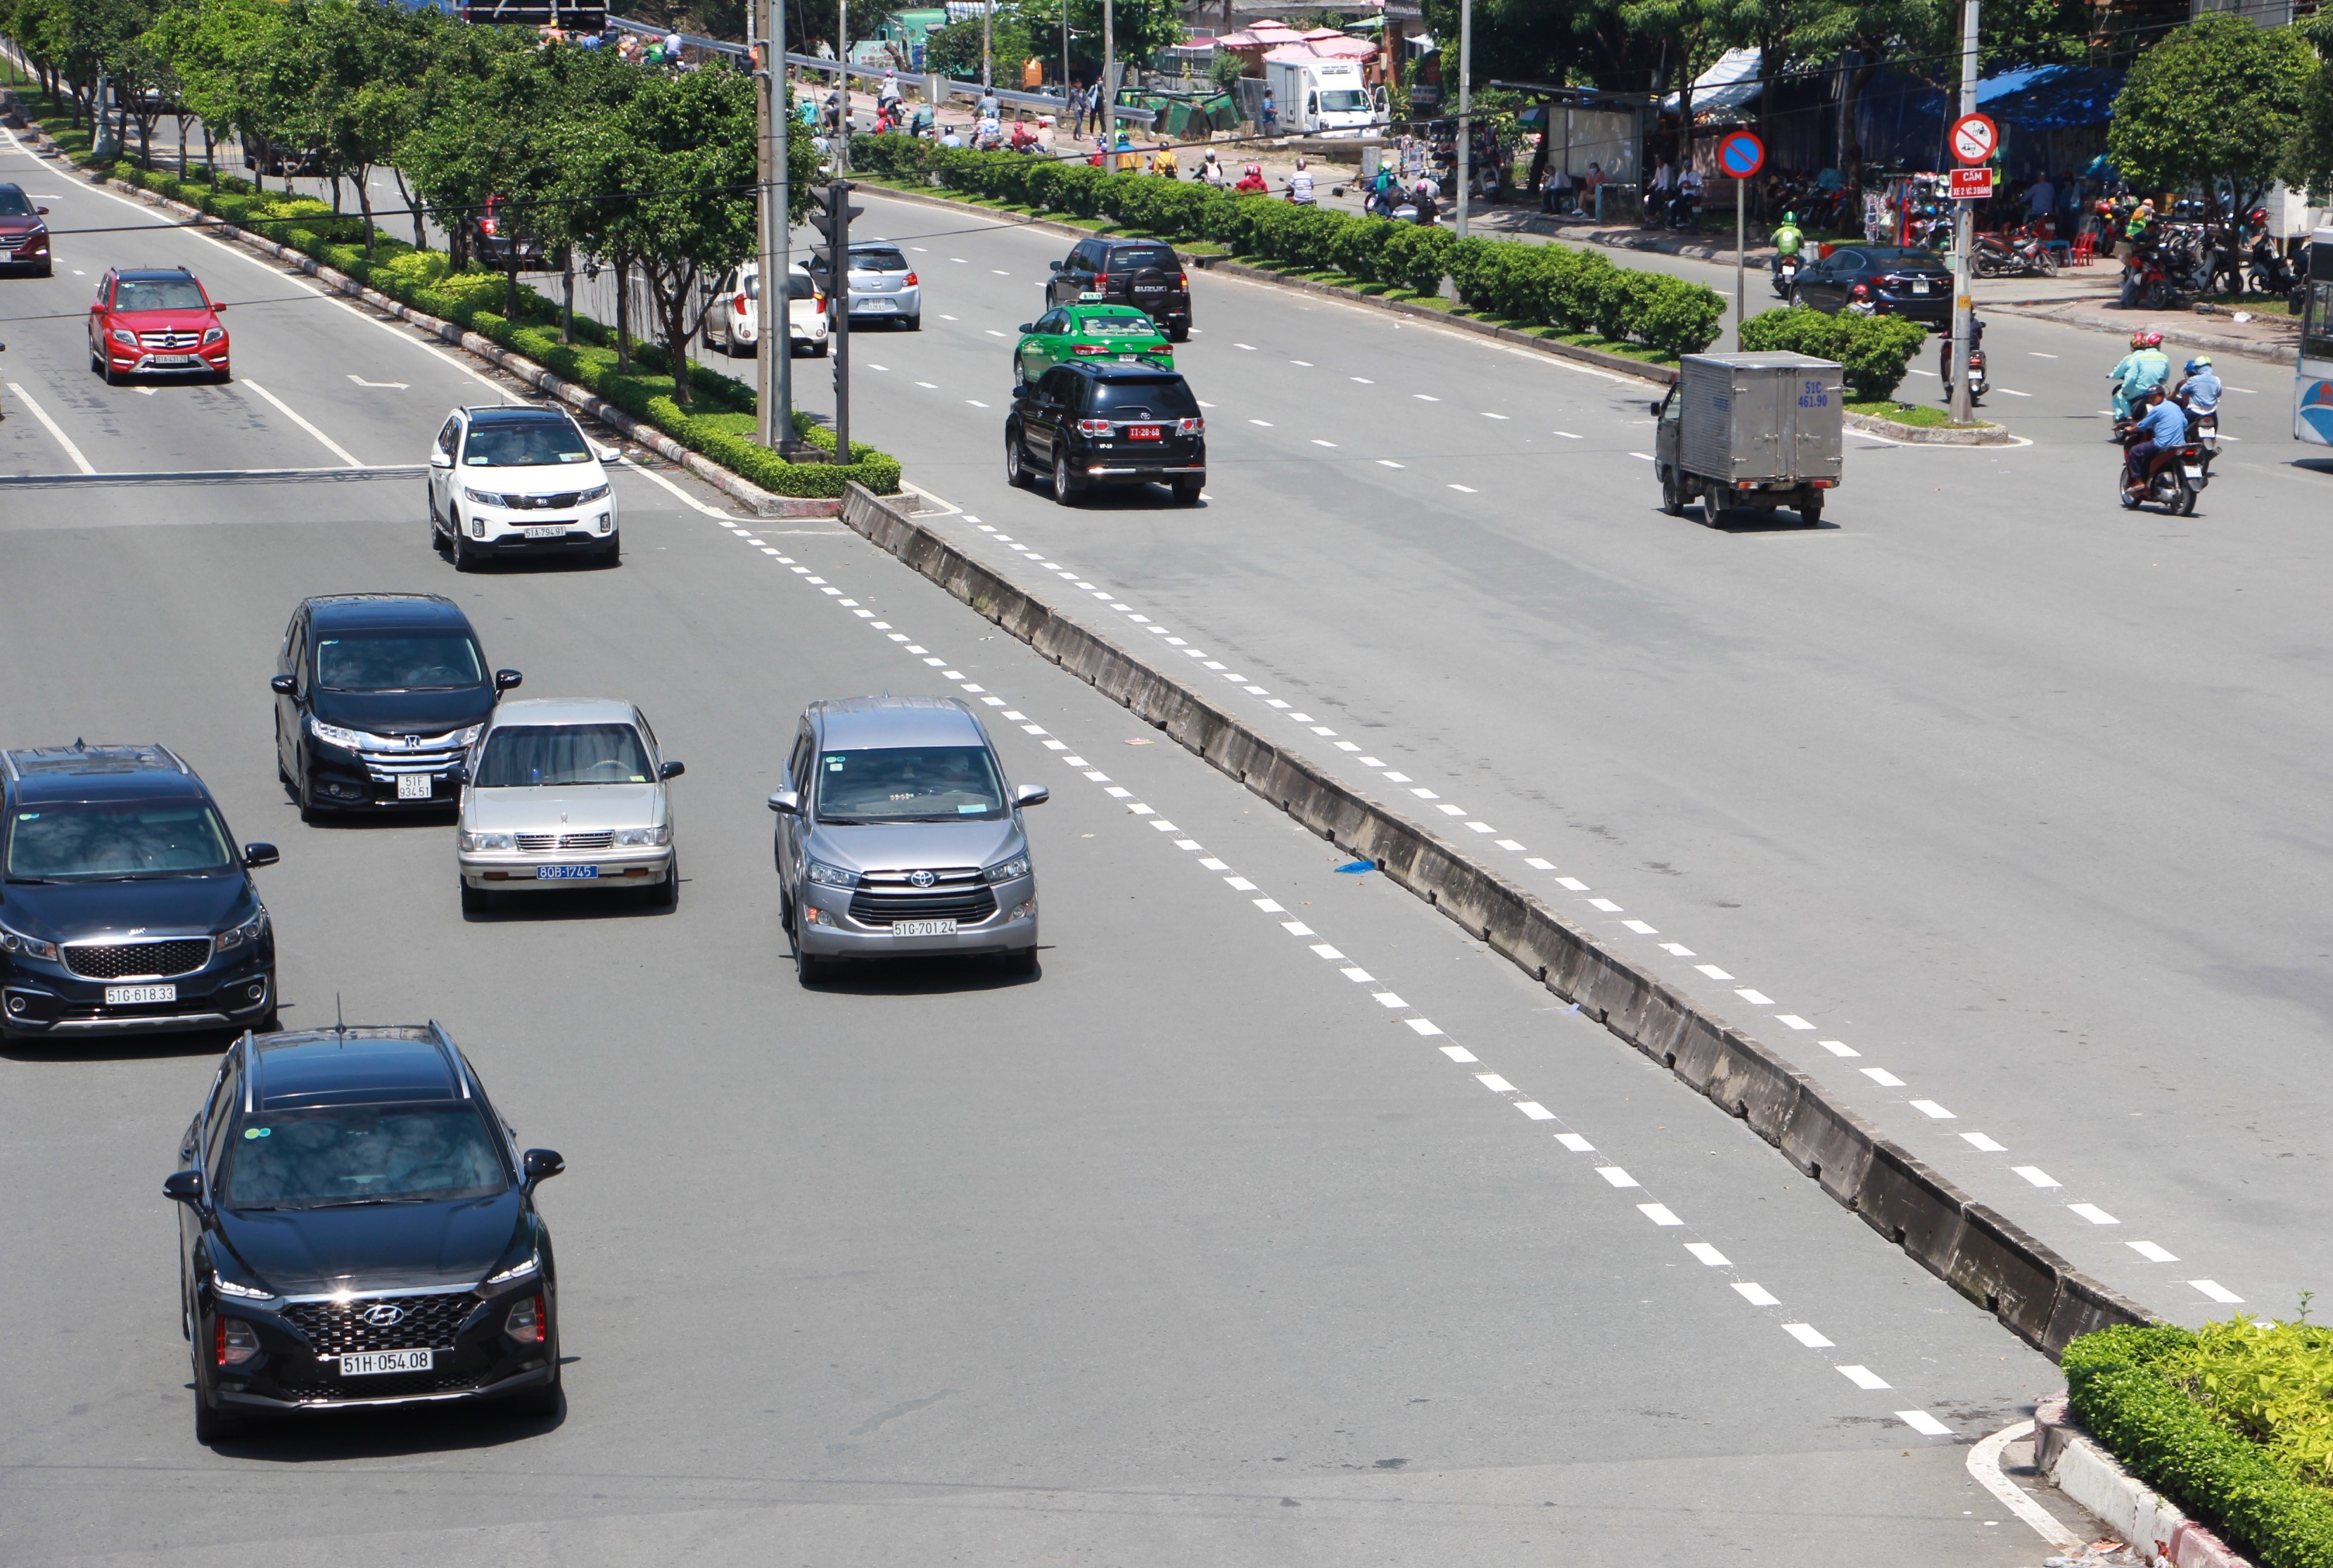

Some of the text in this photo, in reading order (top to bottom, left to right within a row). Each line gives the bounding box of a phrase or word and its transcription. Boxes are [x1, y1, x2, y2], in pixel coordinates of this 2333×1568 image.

[1963, 170, 1983, 181] CẤM
[1953, 187, 1960, 196] XE
[1961, 187, 1965, 196] 2
[1973, 186, 1977, 195] 3
[1977, 184, 1991, 194] BÁNH
[1805, 381, 1822, 394] 51C
[1798, 395, 1827, 407] 461.90
[1130, 428, 1160, 436] TT-28-68
[405, 777, 424, 786] 51F
[400, 787, 429, 797] 934.51
[540, 866, 591, 877] 80B-1745
[895, 921, 955, 935] 51G-701.24
[108, 988, 173, 1002] 51G-618.33
[344, 1352, 428, 1373] 51H-054.08
